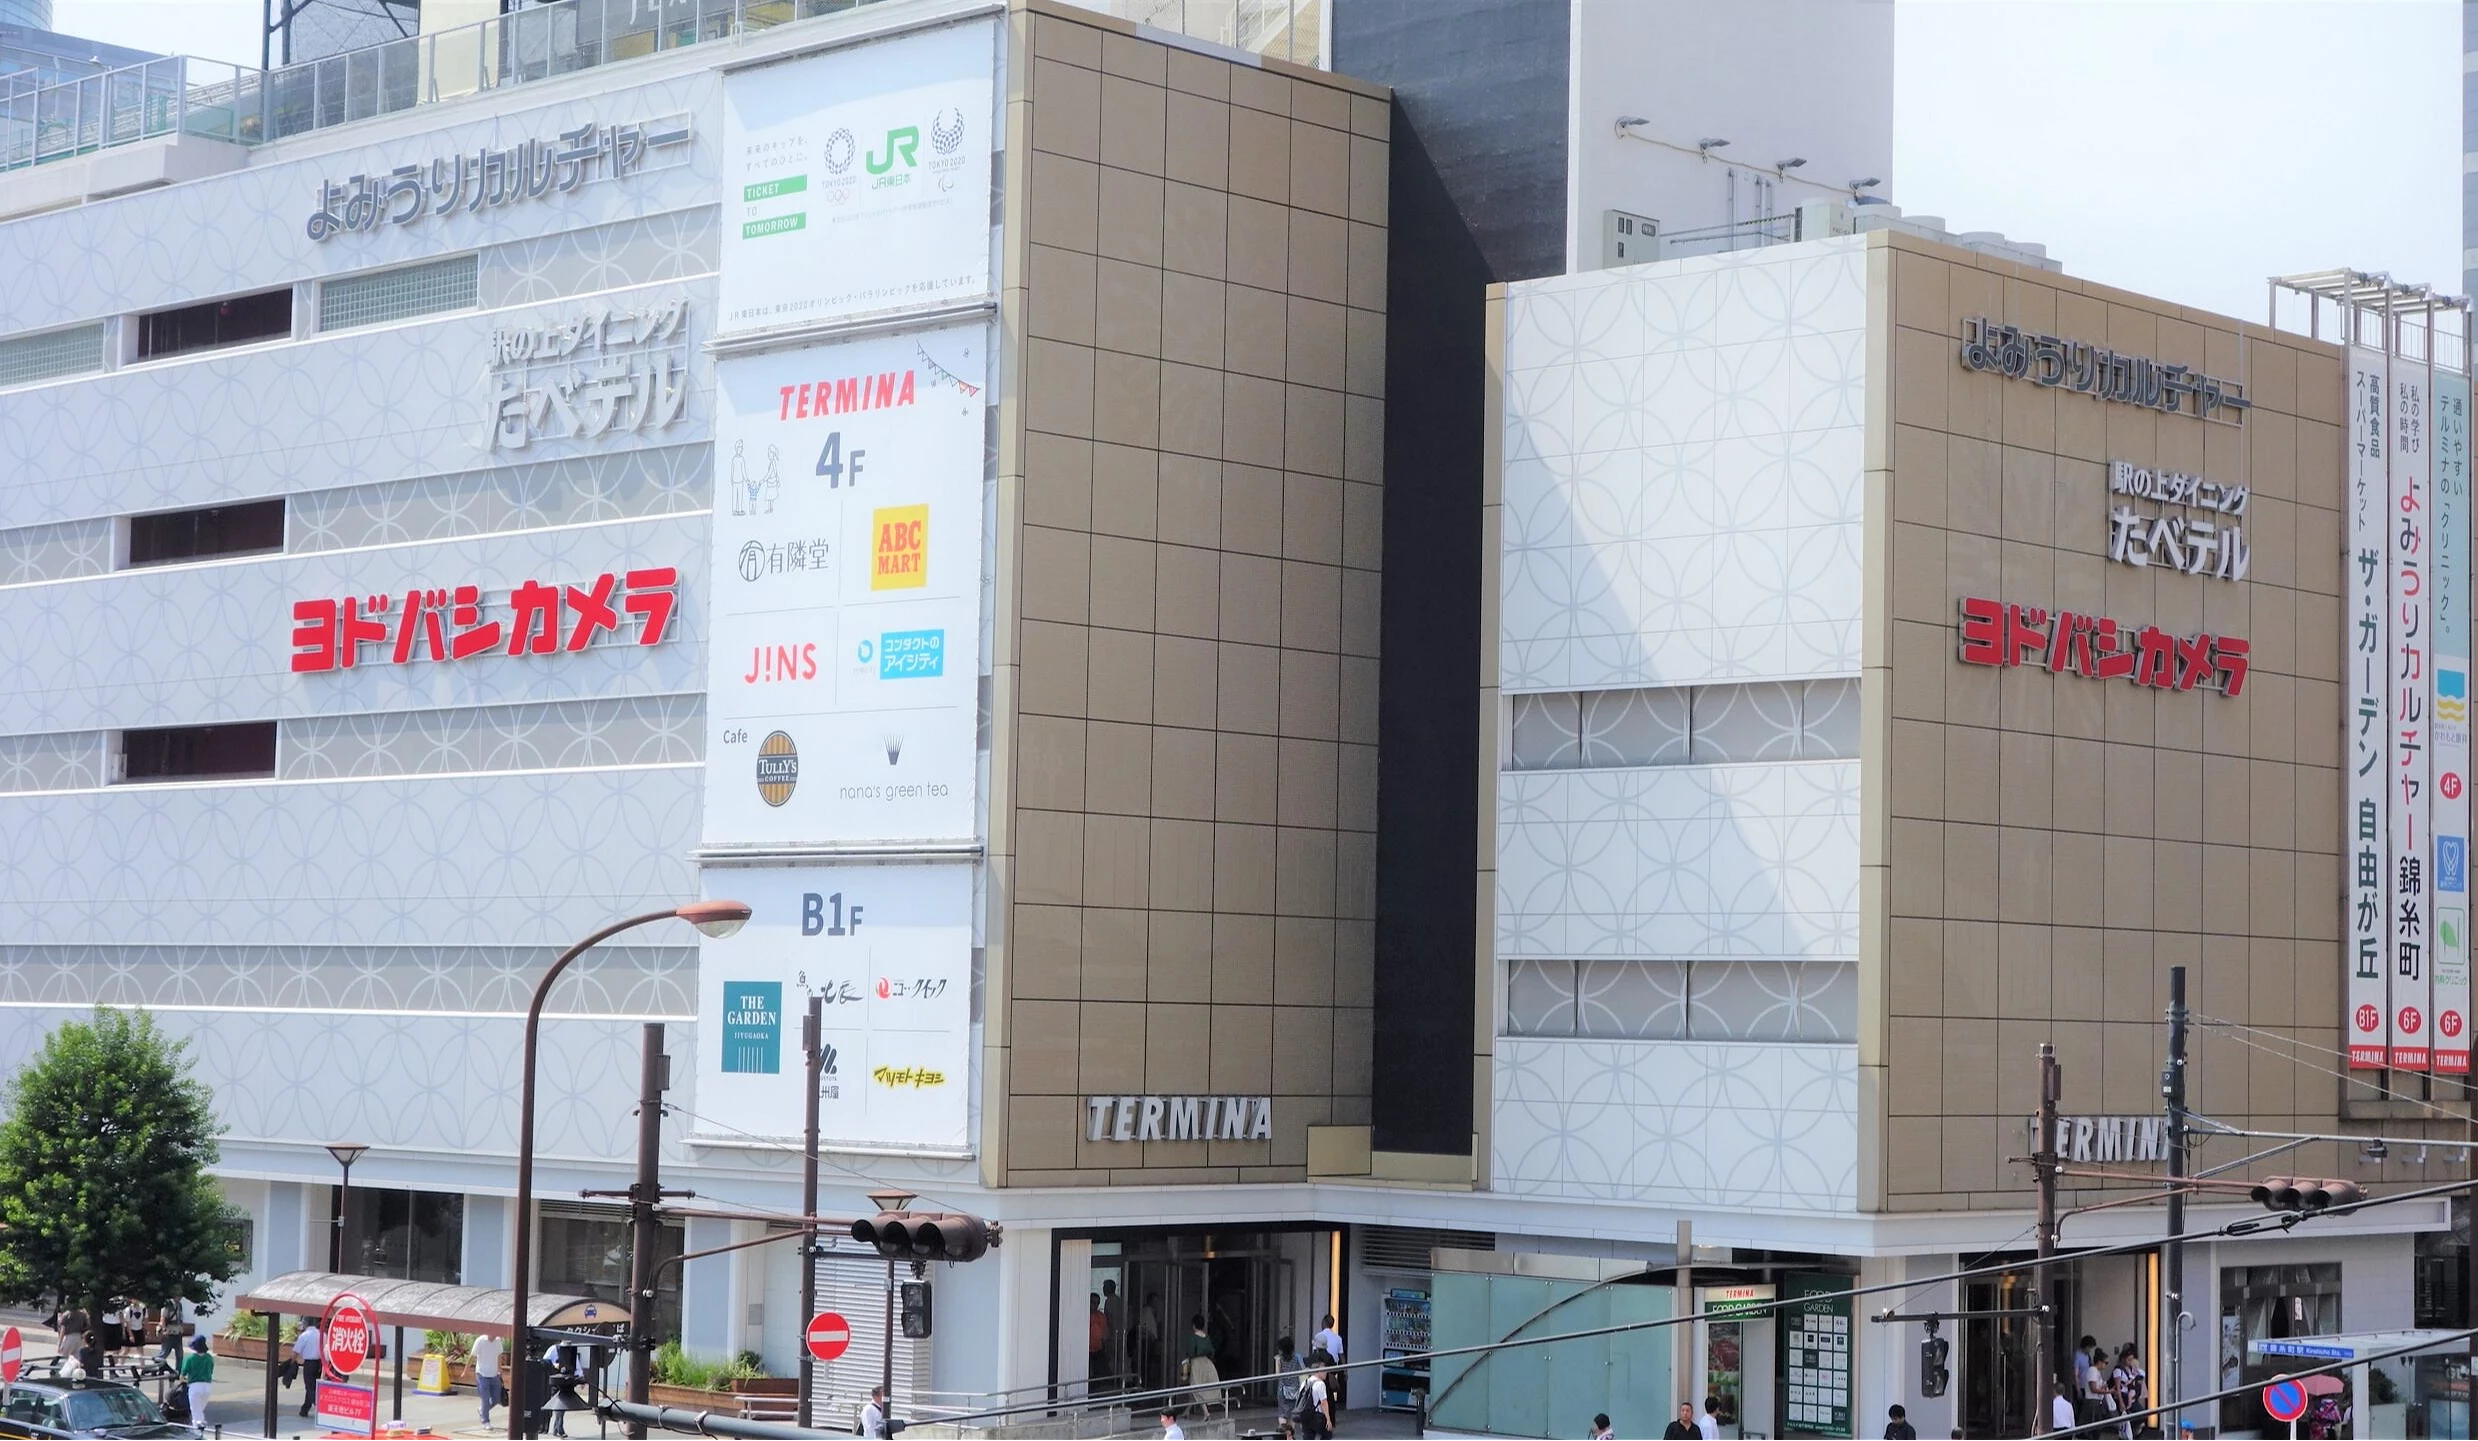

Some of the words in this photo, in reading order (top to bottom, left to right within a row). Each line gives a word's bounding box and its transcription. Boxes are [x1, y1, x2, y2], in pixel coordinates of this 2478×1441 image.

[865, 126, 920, 175] JR
[928, 159, 949, 170] TOKYO
[950, 155, 966, 167] 2020
[307, 122, 690, 242] よみうりカルチャー
[746, 183, 780, 200] TICKET
[871, 174, 912, 190] JR東日本
[746, 206, 758, 217] TO
[745, 216, 799, 237] TOMORROW
[489, 297, 689, 369] 駅の上ダイニング
[1967, 317, 2251, 417] よみうりカルチャー
[779, 369, 915, 421] TERMINA
[2369, 374, 2380, 459] 高質食品
[2400, 383, 2409, 453] 私の時間
[2410, 385, 2420, 453] 私の学び
[2356, 371, 2367, 532] スーパーマーケット
[2453, 397, 2463, 496] 通いやすい
[815, 431, 866, 489] 4F
[2112, 460, 2249, 516] 駅の上ダイニング
[878, 520, 922, 553] ABC
[766, 537, 829, 575] 有隣堂
[877, 552, 921, 576] MART
[290, 567, 679, 673] ヨドバシカメラ
[884, 635, 940, 653] コンタクトの
[1960, 597, 2251, 697] ヨドバシカメラ
[884, 652, 939, 673] アイシティ
[723, 728, 748, 745] Cafe
[764, 774, 790, 782] COFFEE
[2443, 776, 2458, 795] 4F
[840, 785, 881, 799] nana's
[885, 784, 923, 801] green
[926, 781, 948, 797] tea
[2357, 797, 2379, 979] 自由が丘
[801, 892, 864, 937] B1F
[740, 995, 765, 1010] THE
[727, 1010, 777, 1026] GARDEN
[2359, 1009, 2377, 1028] B1F
[2403, 1011, 2418, 1030] 6F
[2444, 1014, 2459, 1033] 6F
[2351, 1050, 2384, 1063] TERMINA
[2395, 1051, 2427, 1064] TERMINA
[2436, 1054, 2467, 1067] TERMINA
[873, 1066, 945, 1089] マツモトキヨシ
[819, 1085, 840, 1100] 州屋
[1087, 1096, 1272, 1142] TERMINA
[2030, 1116, 2169, 1163] ERMIN
[1726, 1288, 1754, 1299] TERMINA
[1803, 1302, 1834, 1313] GARDEN
[330, 1326, 365, 1354] 消火栓
